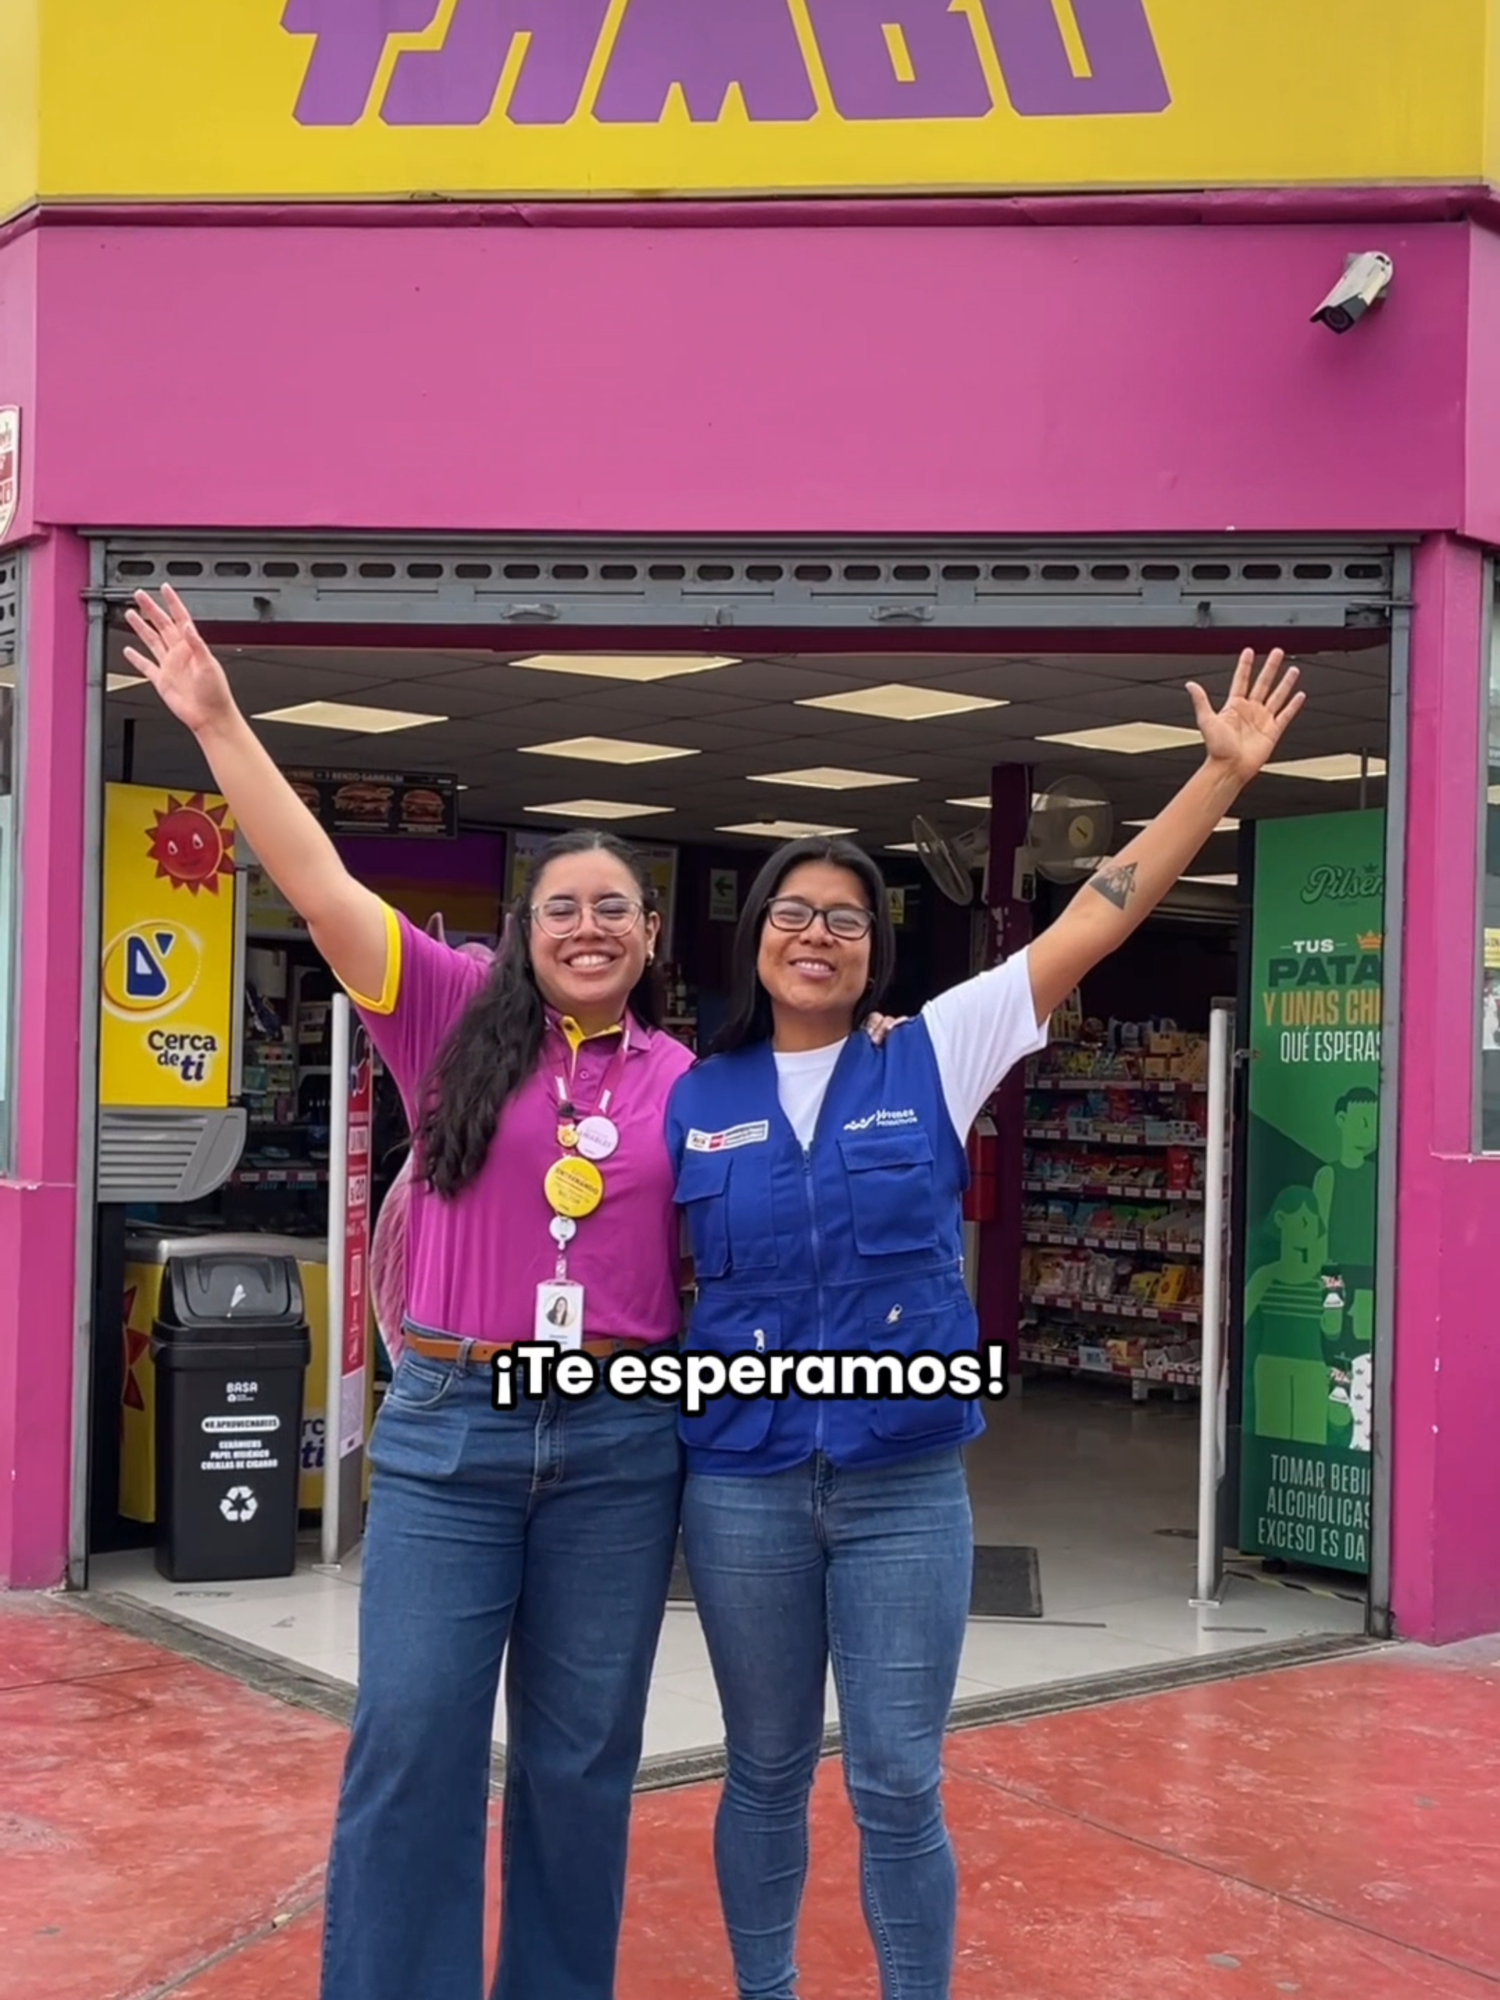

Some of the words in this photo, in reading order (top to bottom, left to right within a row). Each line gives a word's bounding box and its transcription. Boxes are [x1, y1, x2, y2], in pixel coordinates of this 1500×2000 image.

[1293, 939, 1334, 954] TUS
[1262, 992, 1276, 1026] Y
[1281, 990, 1339, 1026] UNAS
[147, 1029, 217, 1051] Cerca
[1280, 1025, 1310, 1063] QUÉ
[157, 1050, 179, 1066] de
[181, 1054, 206, 1081] ti
[226, 1381, 258, 1393] BASA
[1270, 1454, 1326, 1488] TOMAR
[1258, 1517, 1315, 1553] EXCESO
[1320, 1528, 1339, 1558] ES
